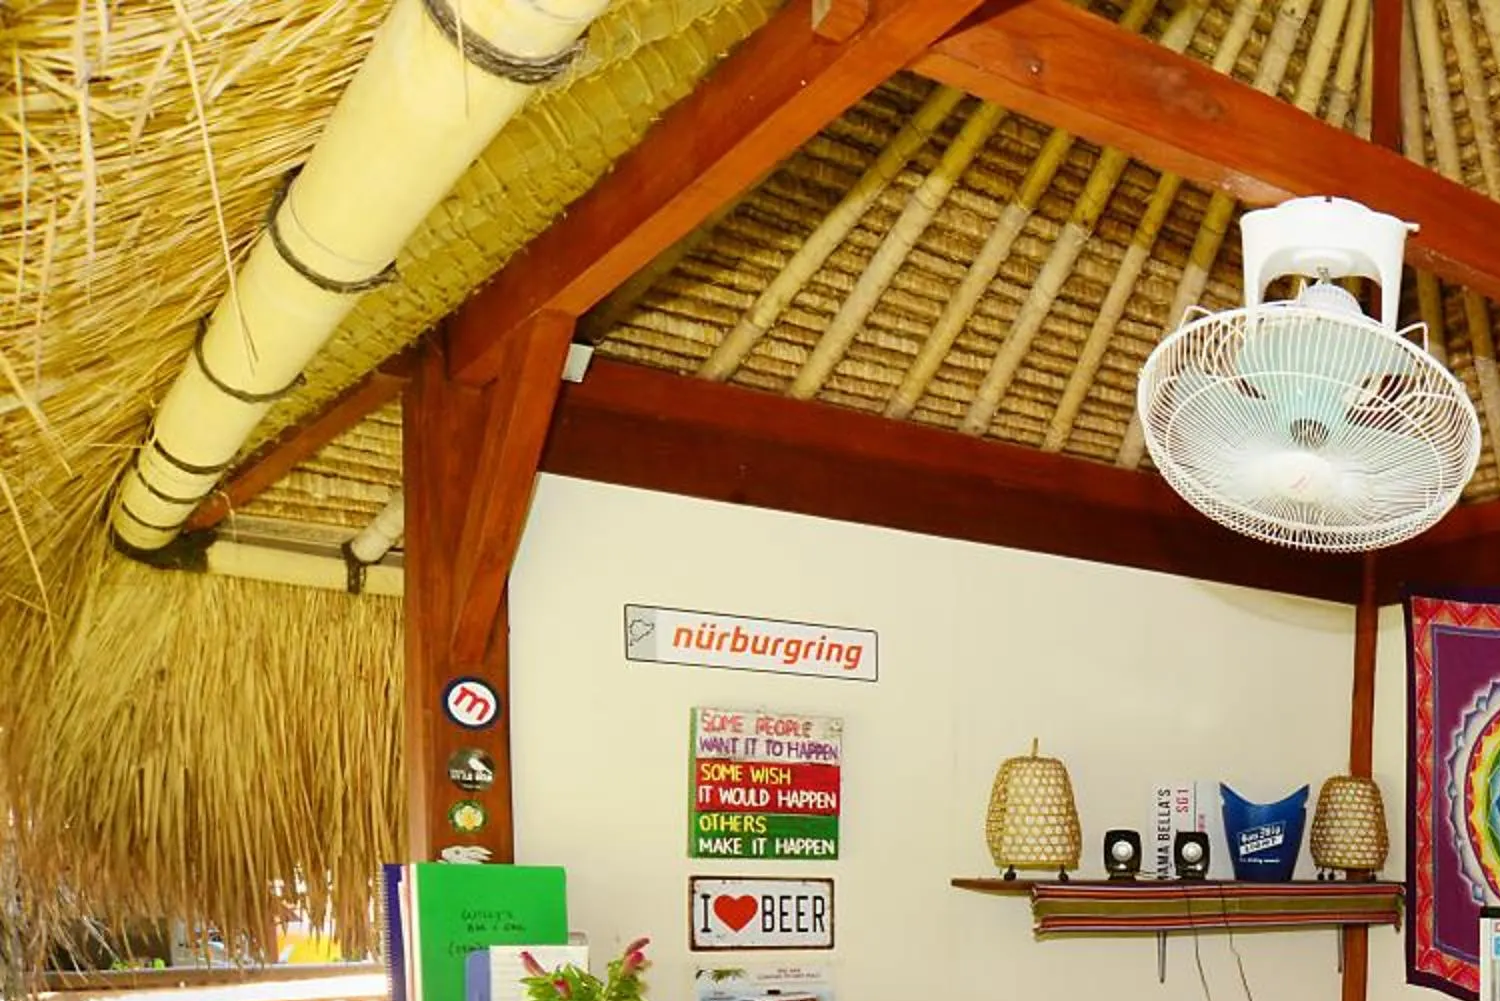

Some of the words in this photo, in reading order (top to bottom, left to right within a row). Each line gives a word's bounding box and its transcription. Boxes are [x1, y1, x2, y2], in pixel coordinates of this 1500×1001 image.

[671, 622, 864, 671] nürburgring
[702, 711, 744, 733] SOME
[755, 715, 813, 738] PEOPLE
[699, 736, 740, 752] WANT
[745, 737, 757, 755] IT
[765, 739, 784, 756] TO
[786, 740, 838, 761] HAPPEN
[701, 763, 743, 782] SOME
[751, 765, 792, 785] WISH
[698, 785, 714, 803] IT
[719, 787, 770, 807] WOULD
[777, 789, 837, 809] HAPPEN
[699, 813, 767, 834] OTHERS
[1157, 788, 1171, 841] BELLA'S
[700, 838, 743, 855] MAKE
[752, 837, 767, 856] IT
[775, 838, 835, 856] HAPPEN
[700, 893, 712, 933] I
[761, 895, 825, 933] BEER
